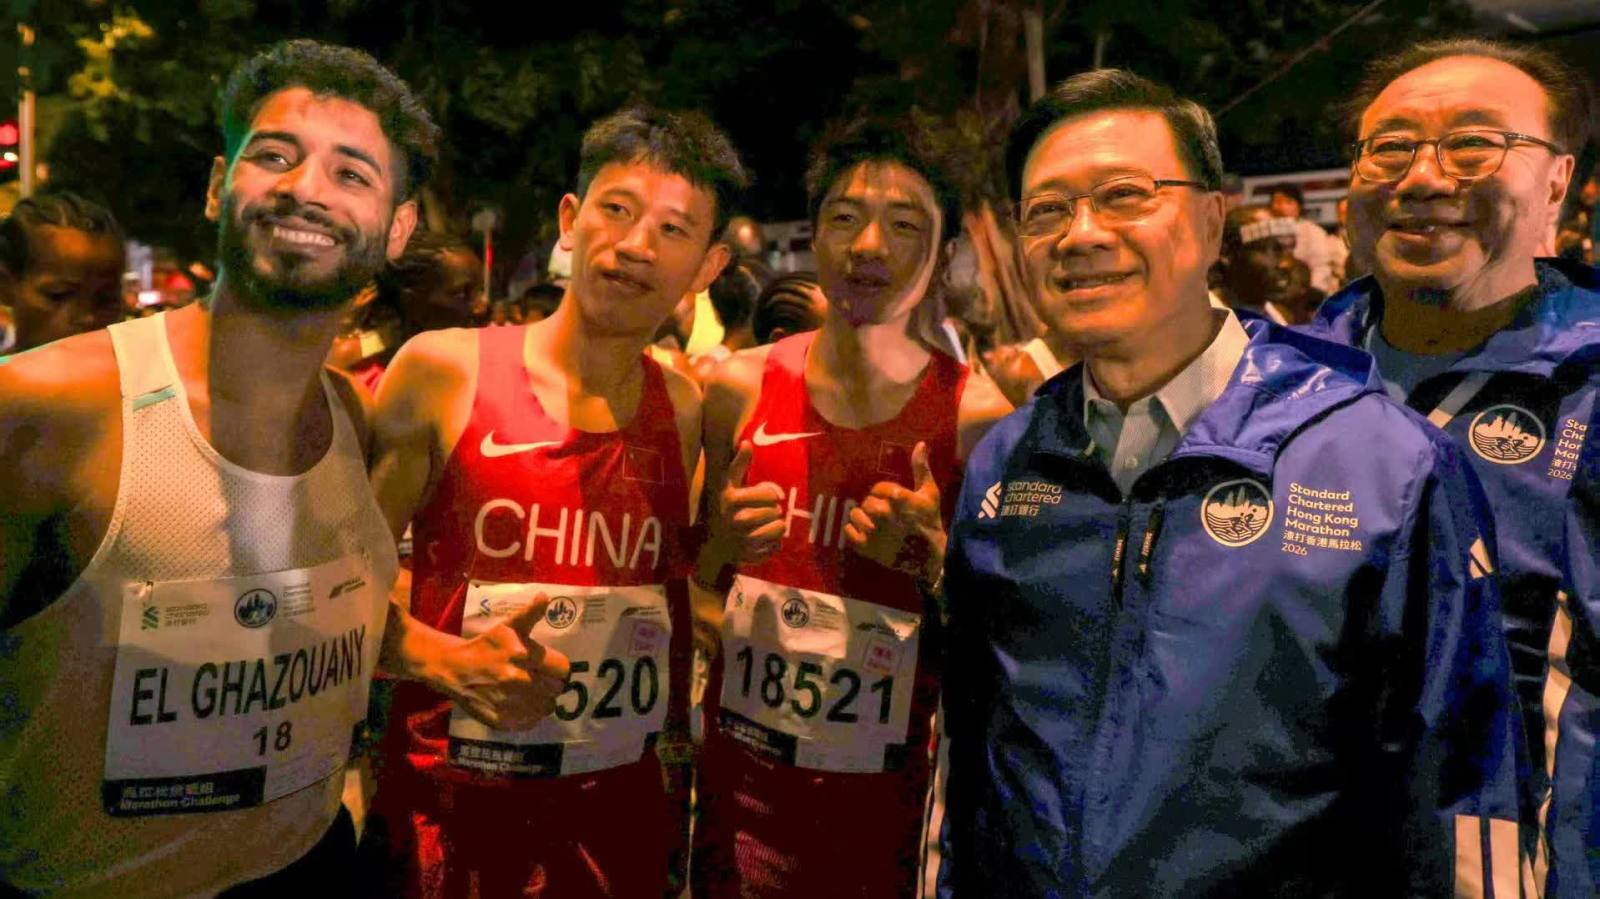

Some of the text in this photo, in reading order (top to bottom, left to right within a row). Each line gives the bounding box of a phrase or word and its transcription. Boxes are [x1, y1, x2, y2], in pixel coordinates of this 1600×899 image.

[1547, 468, 1572, 480] 2026
[1007, 481, 1062, 494] standard
[1289, 482, 1350, 500] Standard
[1004, 492, 1062, 504] chartered
[1288, 494, 1353, 512] Chartered
[1286, 505, 1359, 528] Hong Kong
[474, 498, 662, 570] CHINA
[1284, 517, 1350, 537] Marathon
[1281, 542, 1308, 556] 2026
[1283, 531, 1362, 551] 渣打香港馬拉松
[130, 625, 366, 726] EL GHAZOUANY
[736, 646, 894, 725] 18521
[253, 721, 293, 756] 18
[120, 793, 241, 810] Marathon Challenge
